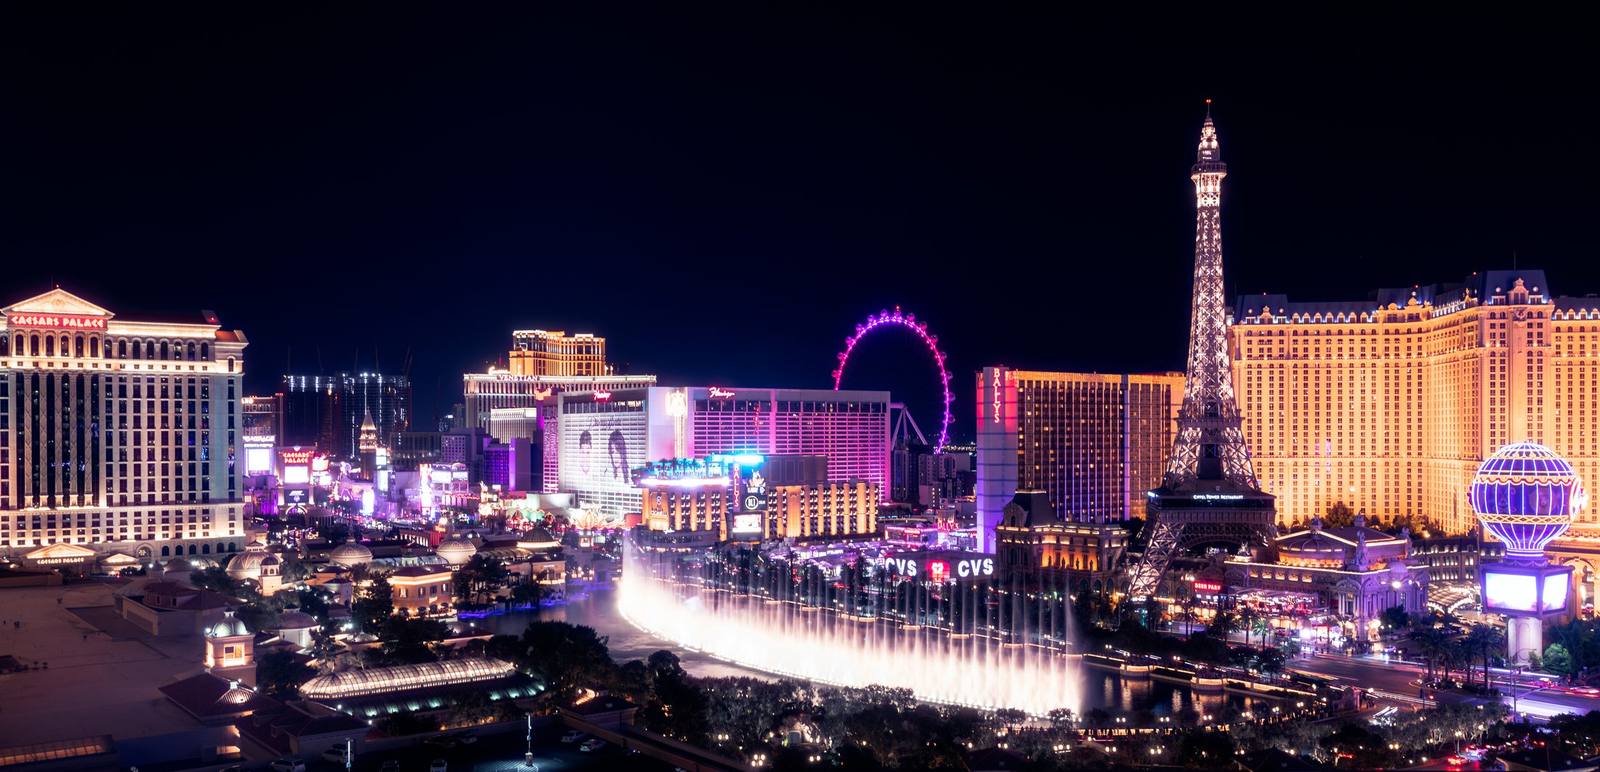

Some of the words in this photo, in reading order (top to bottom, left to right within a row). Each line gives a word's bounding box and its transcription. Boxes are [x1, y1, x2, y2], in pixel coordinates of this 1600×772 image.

[11, 316, 60, 326] CAESARS
[62, 318, 104, 328] PALACE
[957, 558, 994, 577] CVS
